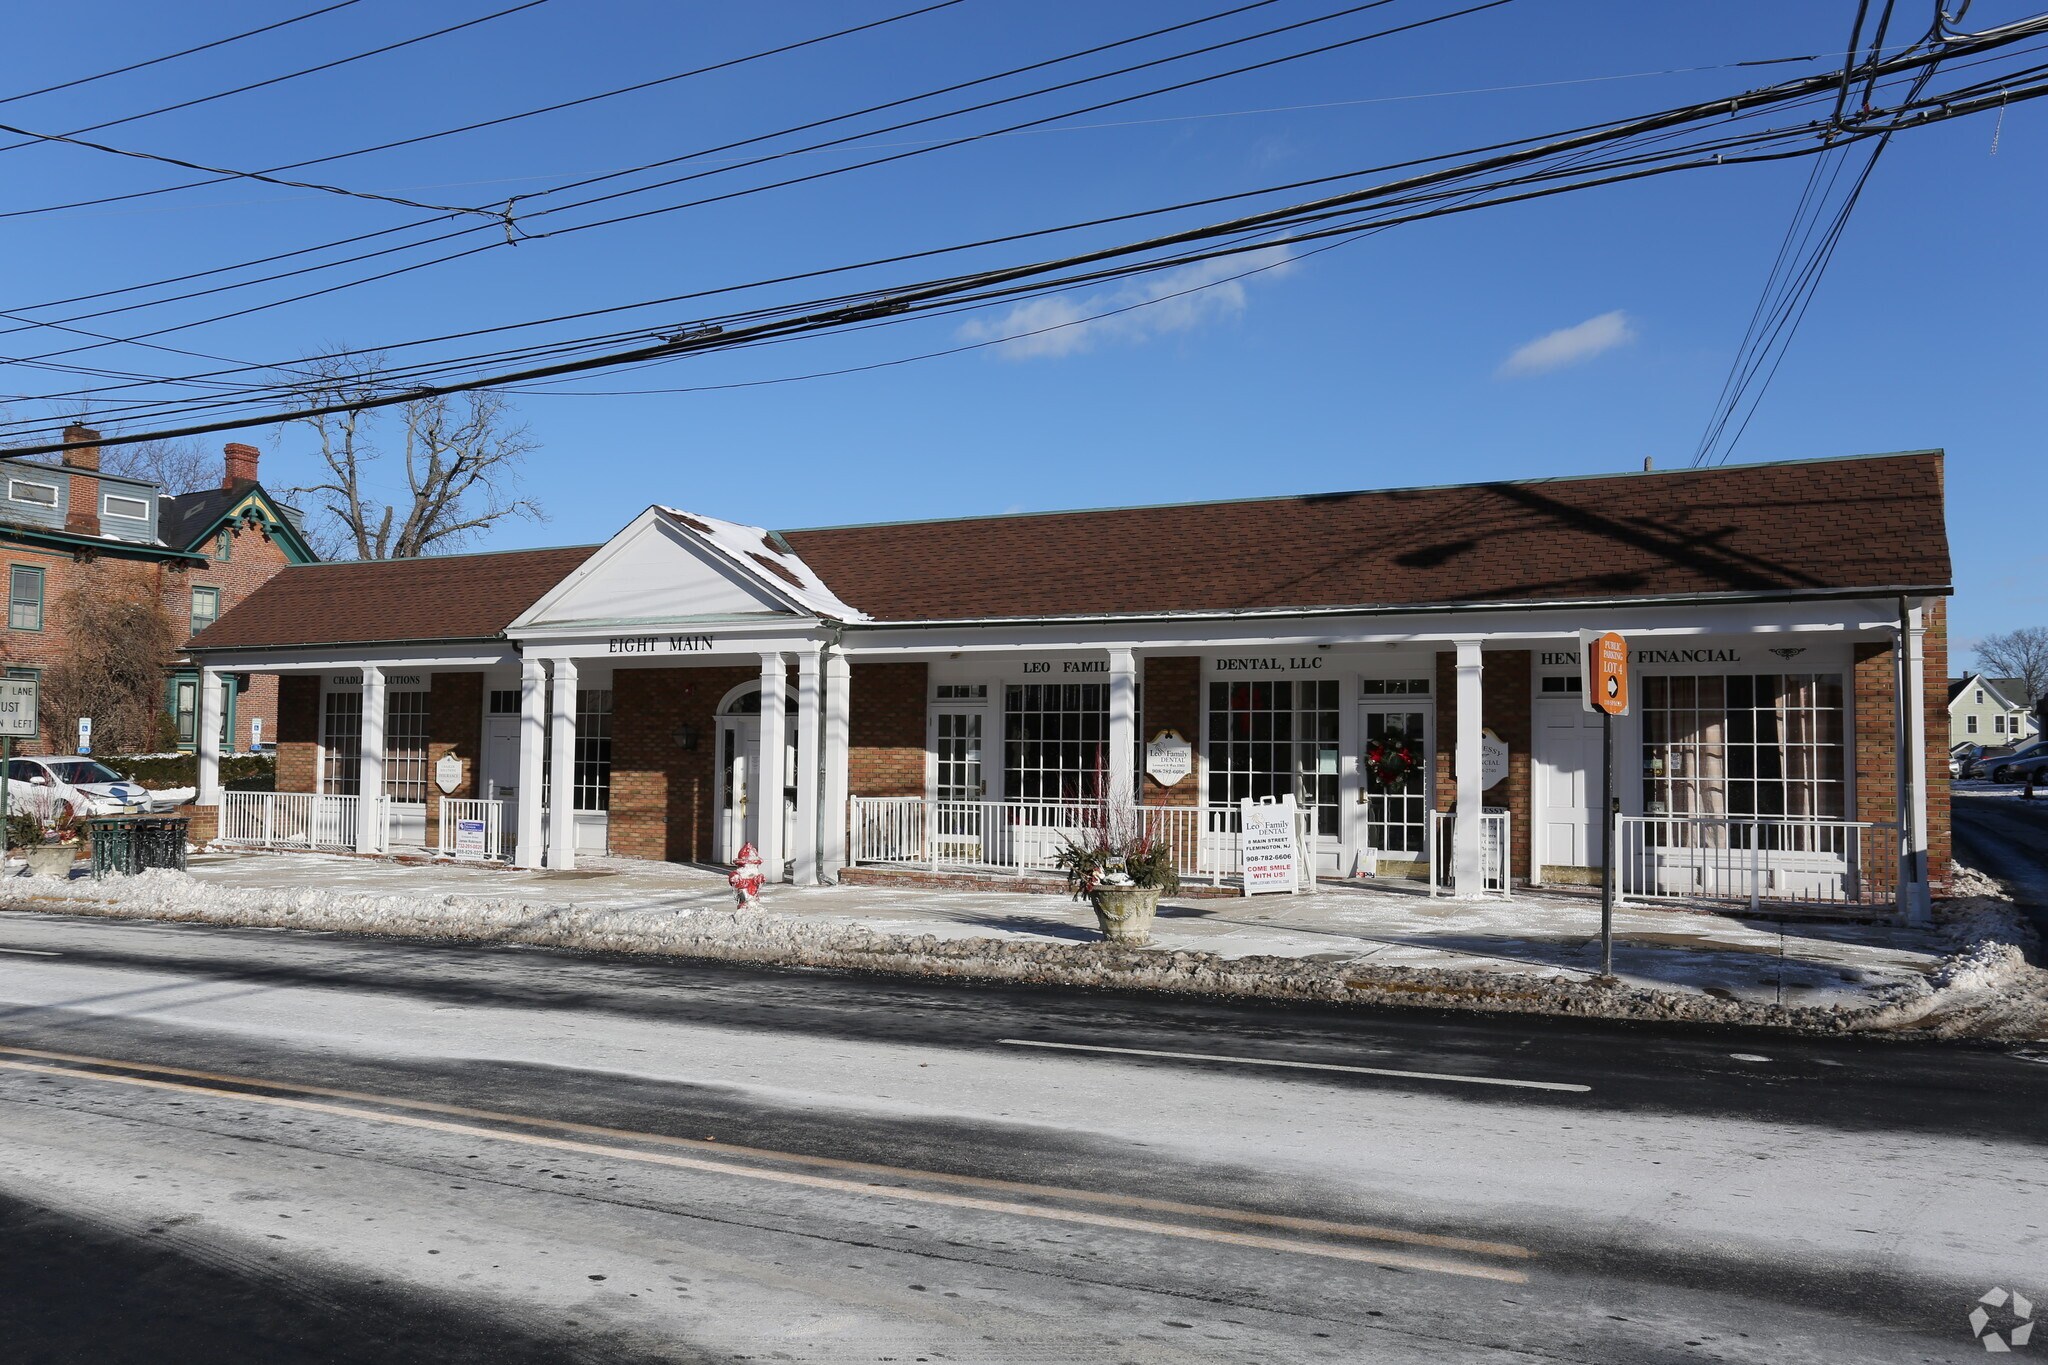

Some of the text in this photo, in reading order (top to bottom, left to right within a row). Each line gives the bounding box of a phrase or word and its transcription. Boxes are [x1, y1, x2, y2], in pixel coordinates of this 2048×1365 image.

[609, 635, 713, 653] EIGHT MAIN
[1604, 640, 1622, 651] PUBLIC
[1603, 650, 1623, 661] PARKING
[1638, 649, 1741, 663] FINANCIAL
[1023, 656, 1322, 673] LEO FAMIL DENTAL, LLC
[1603, 661, 1623, 675] LOT 4
[333, 676, 420, 685] CHADL LUTIONS
[12, 687, 33, 696] LANE
[1, 702, 20, 713] UST
[13, 719, 33, 728] LEFT
[1166, 750, 1188, 758] Family
[1265, 820, 1289, 830] Family
[1246, 854, 1292, 862] 908-782-6606
